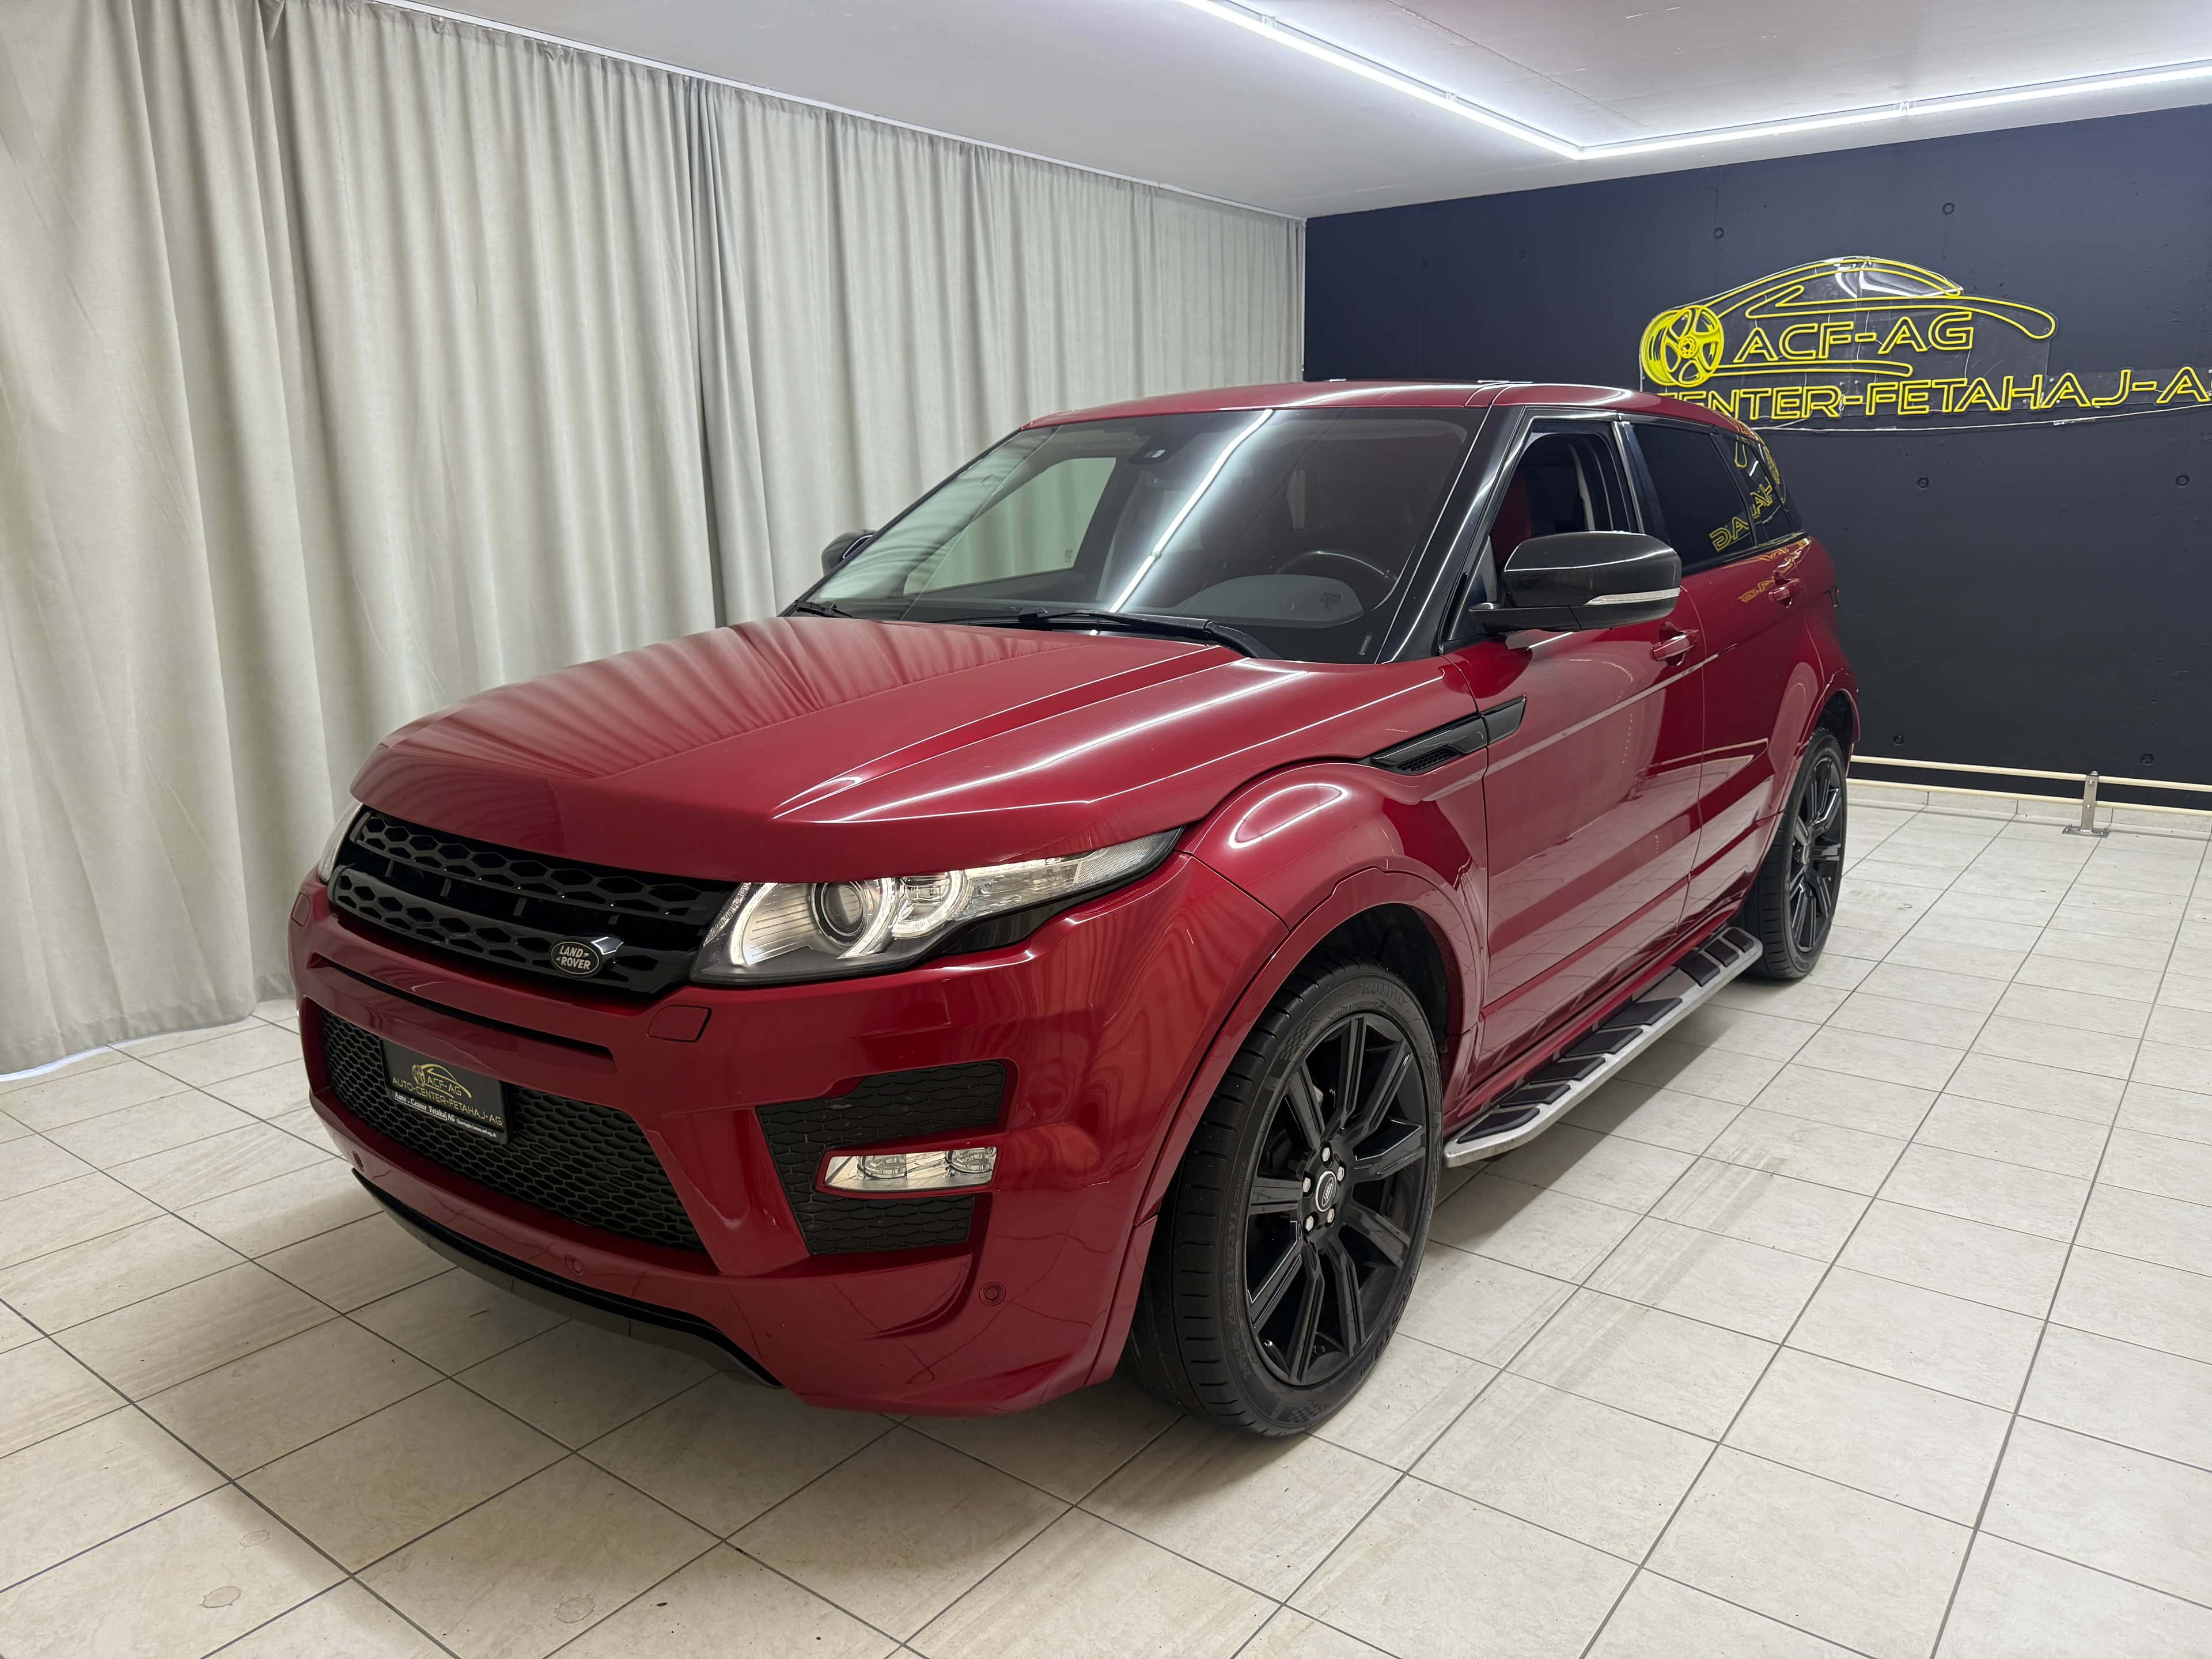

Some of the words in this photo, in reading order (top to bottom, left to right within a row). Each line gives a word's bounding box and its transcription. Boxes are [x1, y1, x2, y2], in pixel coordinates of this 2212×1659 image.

[1733, 311, 1974, 363] ACF-AG
[559, 945, 584, 958] LAND
[560, 957, 591, 970] ROVER
[427, 1075, 462, 1096] ACF-AG
[392, 1076, 502, 1126] AUTO-CENTER-FETAHAJ-AG
[447, 1113, 455, 1122] AG
